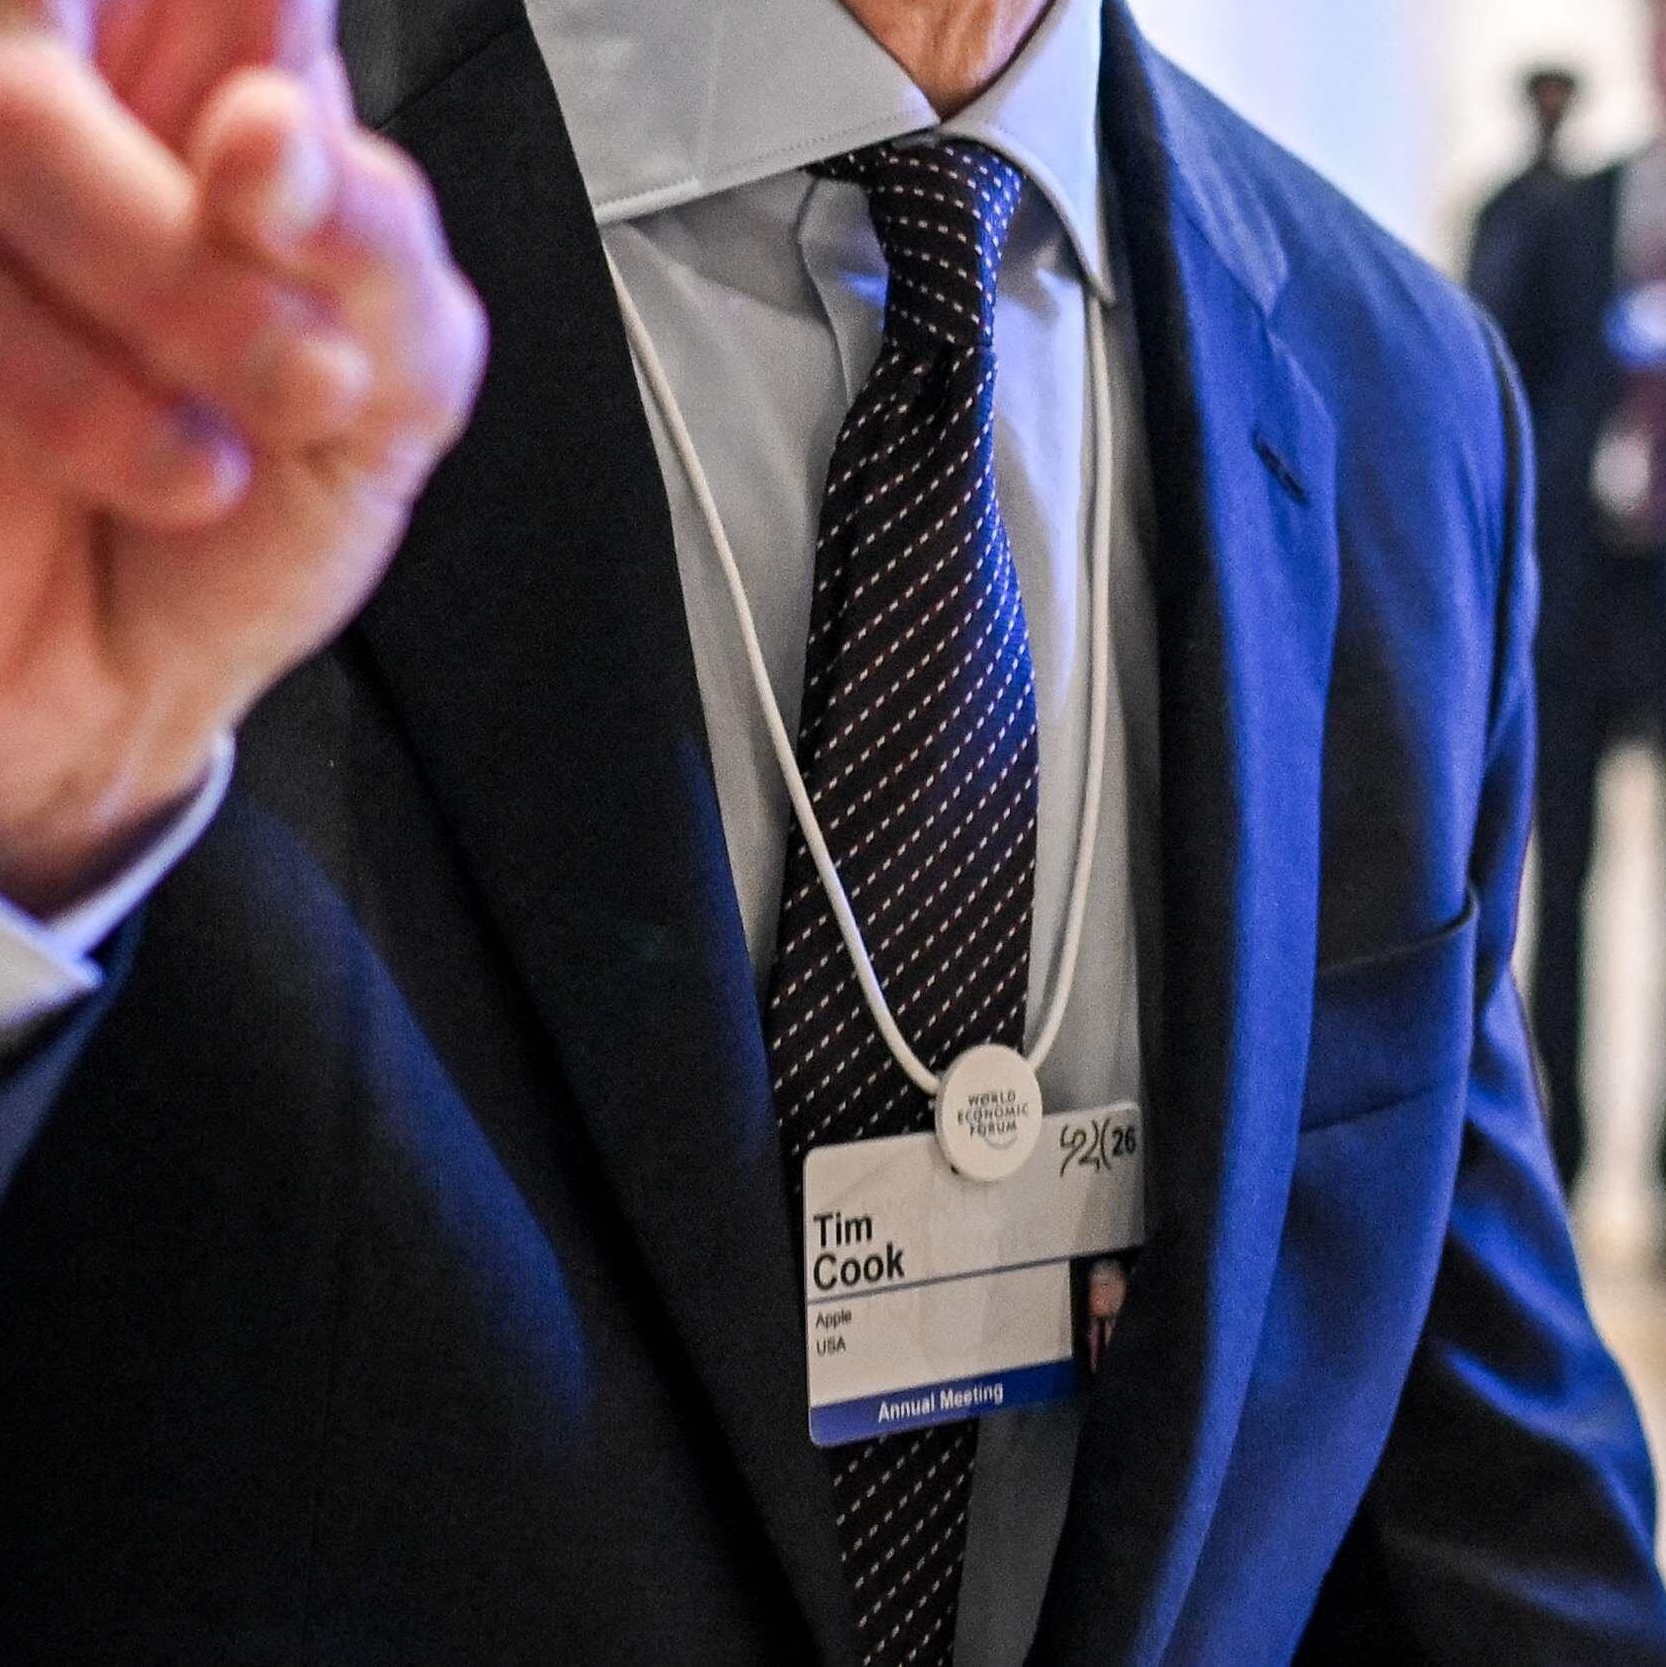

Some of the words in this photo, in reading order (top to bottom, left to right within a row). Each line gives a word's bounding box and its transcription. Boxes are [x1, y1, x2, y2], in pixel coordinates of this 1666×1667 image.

[968, 1090, 1016, 1106] WORLD
[958, 1102, 1028, 1124] ECONOMIC
[969, 1120, 1017, 1137] FORUM
[813, 1211, 873, 1248] Tim
[813, 1241, 905, 1292] Cook
[815, 1308, 852, 1329] Apple
[816, 1336, 846, 1356] USA
[877, 1390, 935, 1423] Annual
[940, 1382, 1005, 1410] Meeting
